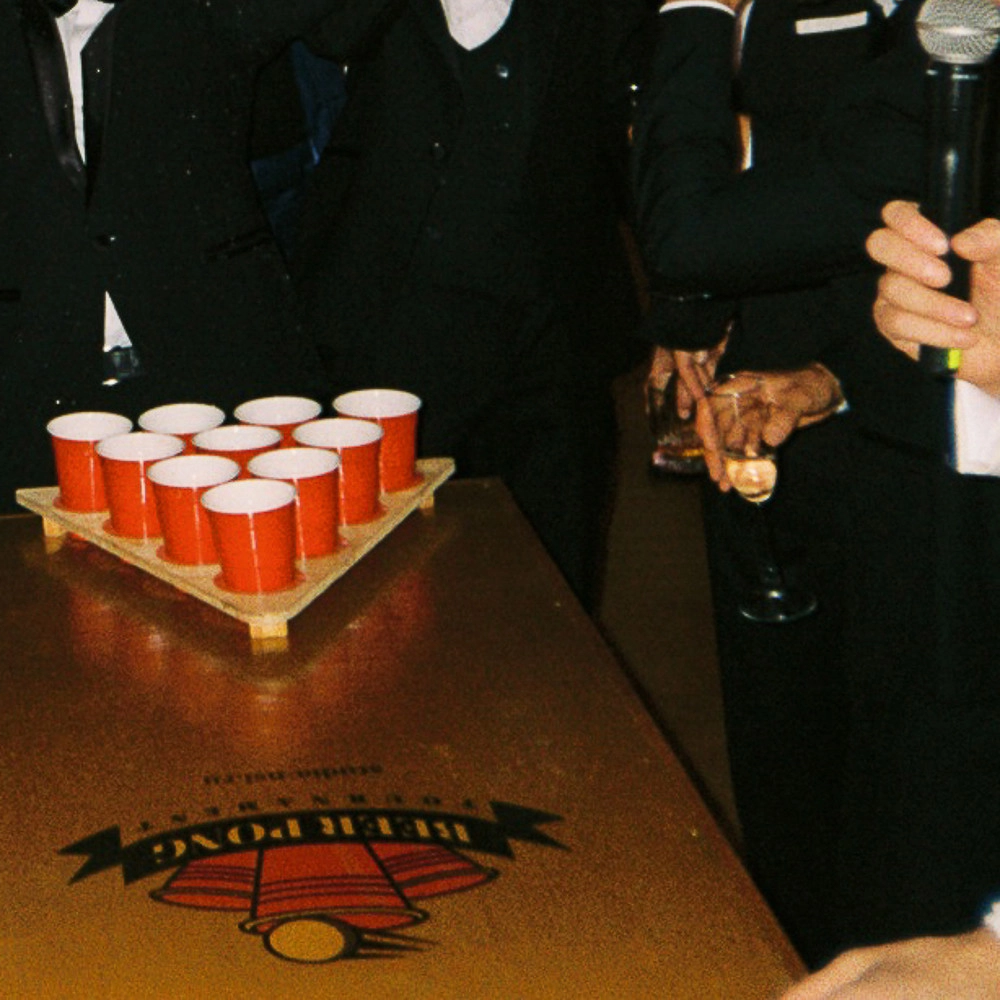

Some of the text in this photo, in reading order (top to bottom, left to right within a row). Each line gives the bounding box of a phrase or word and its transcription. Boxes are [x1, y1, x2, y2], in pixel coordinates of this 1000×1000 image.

[138, 794, 476, 830] TOURNAMENT
[151, 816, 474, 864] BEER PONG
